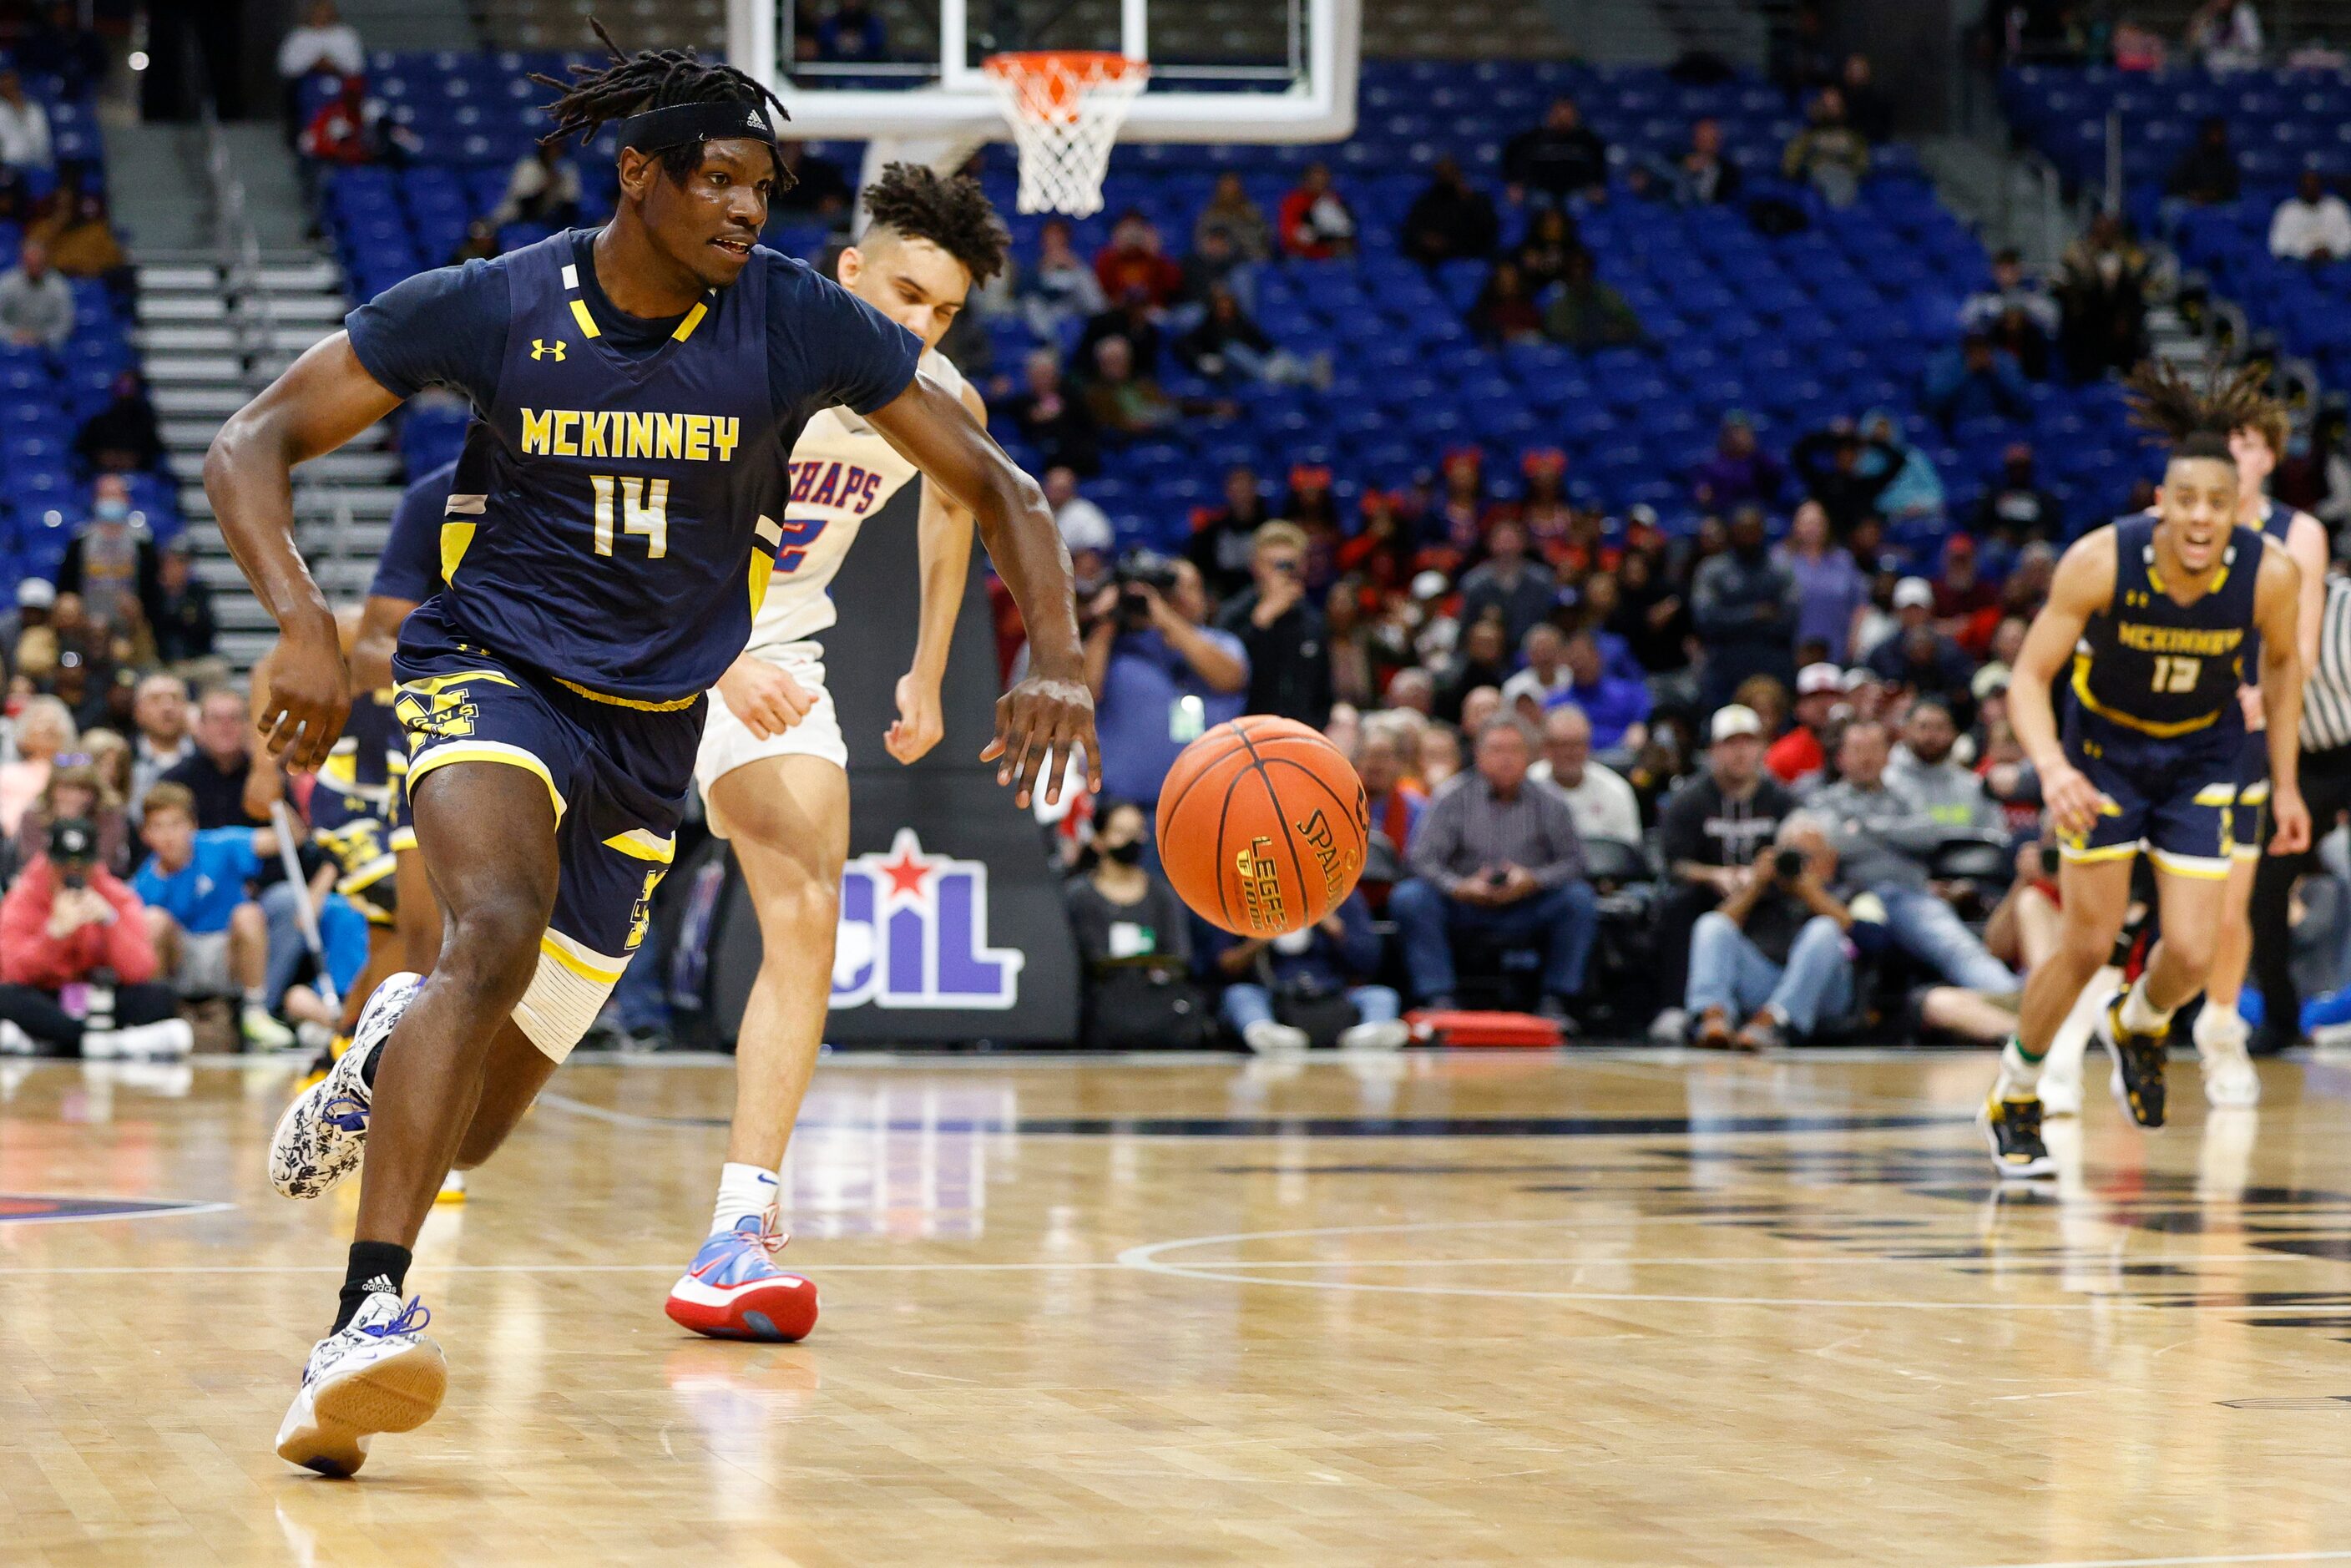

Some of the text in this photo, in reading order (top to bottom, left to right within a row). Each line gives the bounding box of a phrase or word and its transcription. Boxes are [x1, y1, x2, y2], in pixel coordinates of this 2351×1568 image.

[520, 407, 740, 462] MCKINNEY
[589, 475, 670, 559] 14
[361, 1282, 397, 1293] adidas
